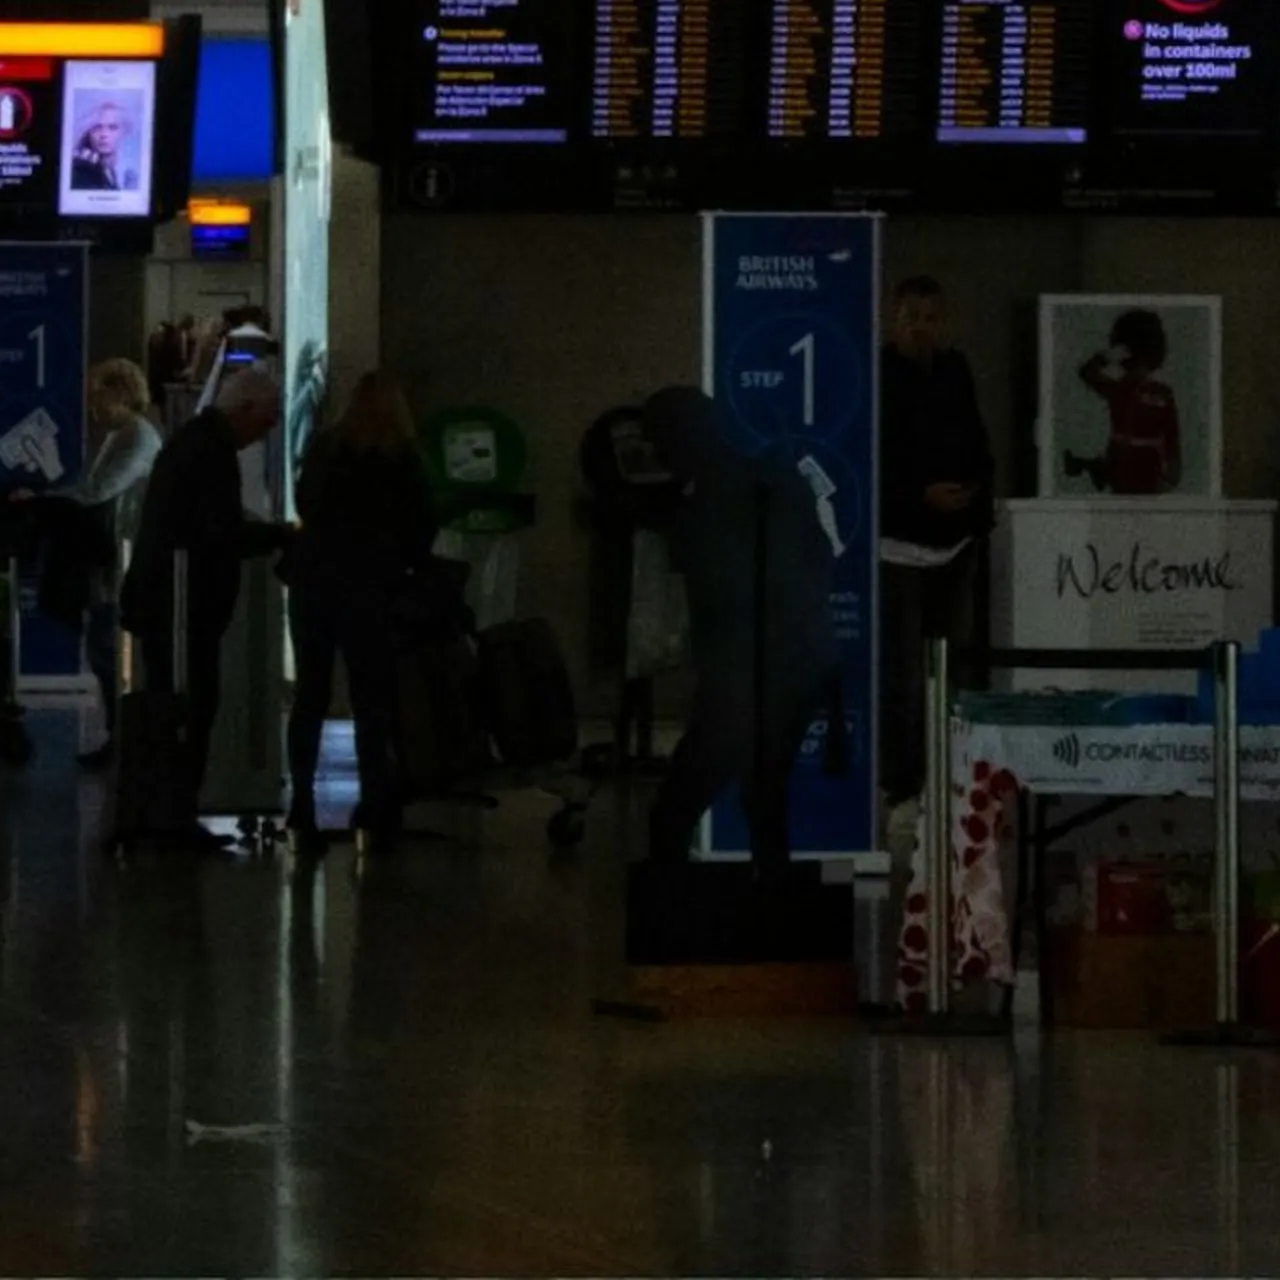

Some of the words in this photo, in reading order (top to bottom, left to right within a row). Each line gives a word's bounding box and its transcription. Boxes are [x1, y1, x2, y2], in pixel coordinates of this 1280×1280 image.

[1144, 23, 1170, 40] No
[1173, 22, 1230, 43] liquids
[1143, 43, 1161, 59] in
[1164, 43, 1252, 59] containers
[1143, 64, 1181, 80] over
[738, 255, 815, 273] BRITISH
[735, 273, 819, 292] AIRWAYS
[789, 331, 815, 427] 1
[1057, 541, 1235, 600] Welcome
